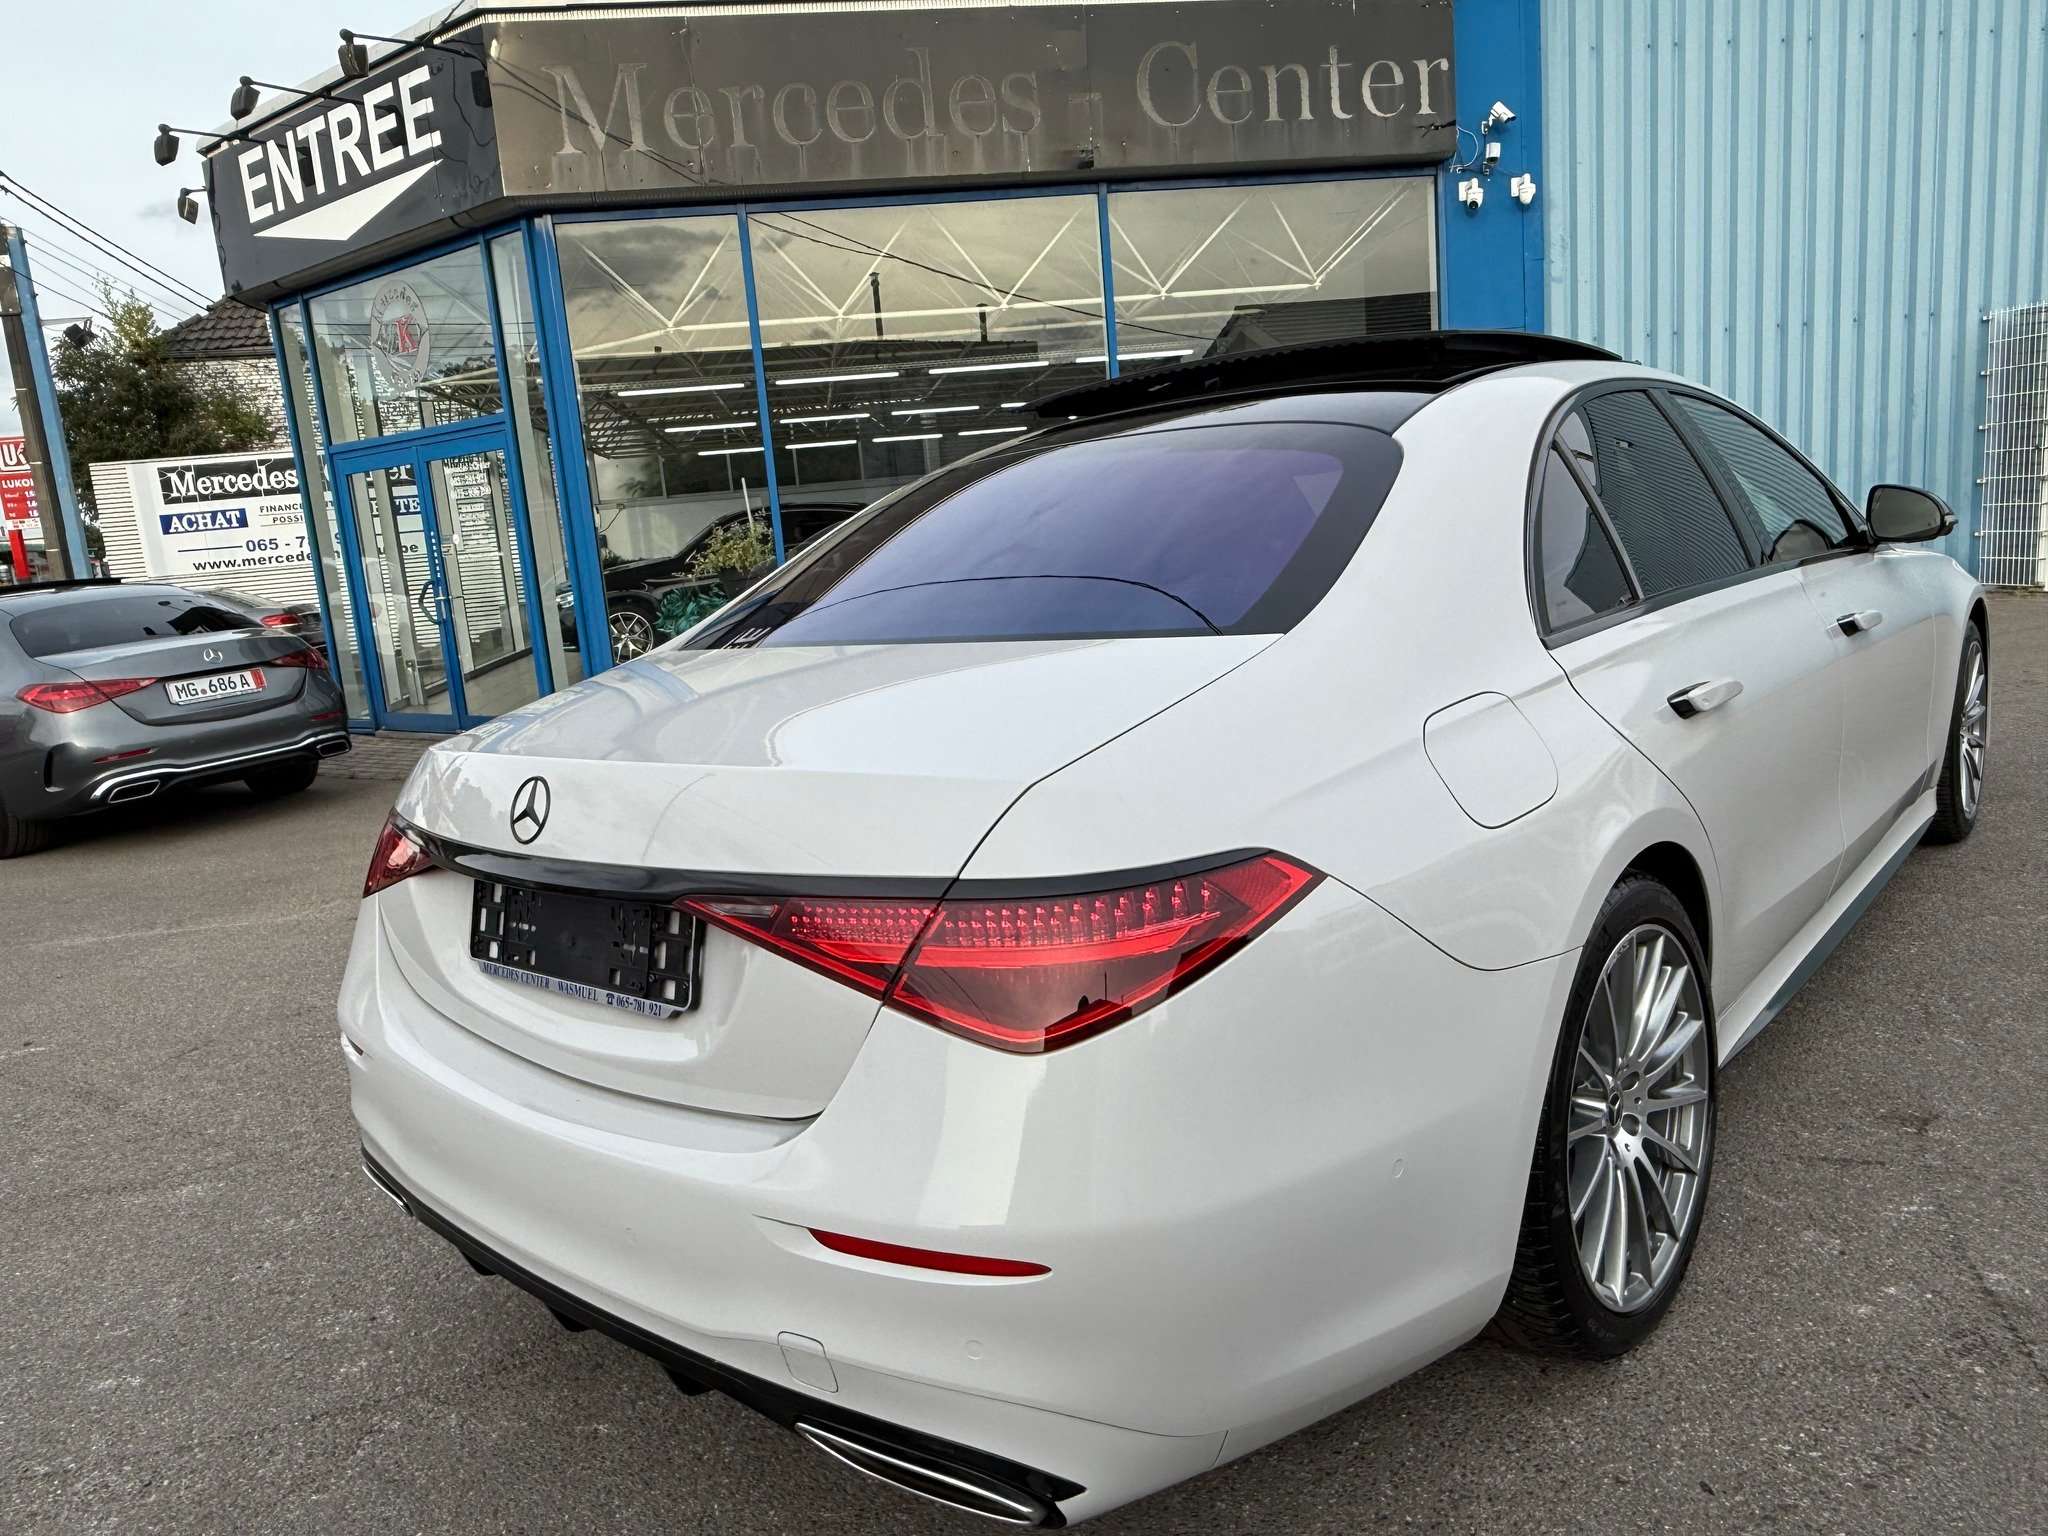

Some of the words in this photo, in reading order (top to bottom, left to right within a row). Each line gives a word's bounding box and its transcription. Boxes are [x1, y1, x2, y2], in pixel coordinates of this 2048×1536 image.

[541, 46, 1042, 155] Mercedes
[1137, 41, 1450, 126] Center
[238, 64, 442, 224] ENTREE
[169, 464, 299, 497] Mercedes
[169, 511, 241, 533] ACHAT
[272, 515, 303, 524] POSSI
[245, 538, 279, 552] 065
[482, 962, 520, 983] MERCEDES
[521, 970, 550, 989] CENTER
[558, 980, 598, 1001] WASMUEL
